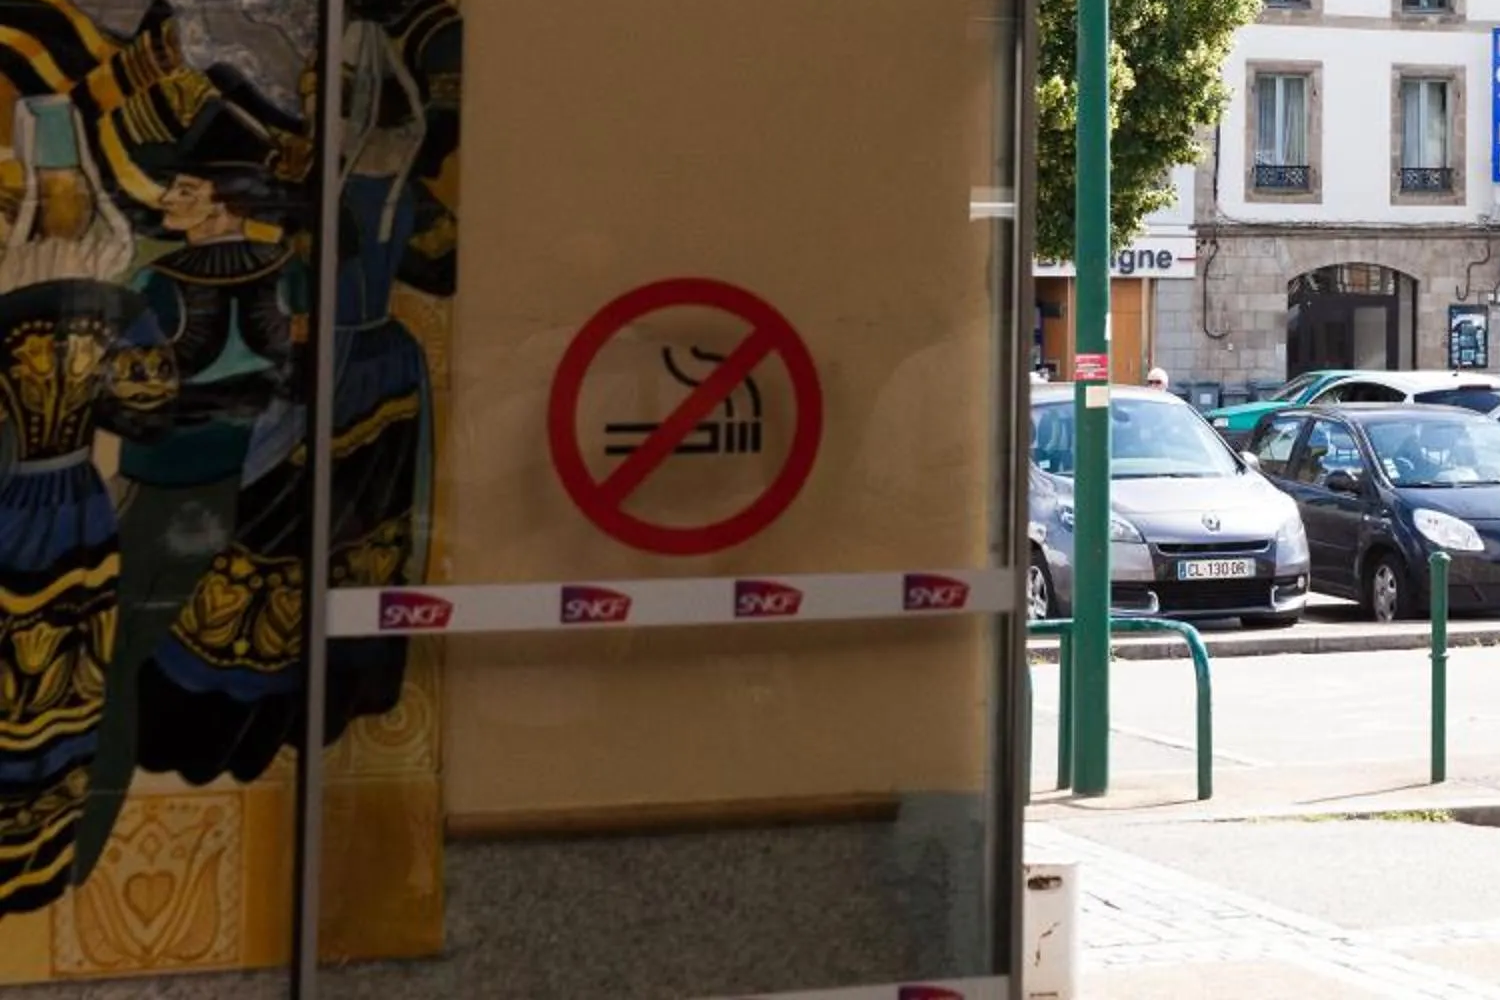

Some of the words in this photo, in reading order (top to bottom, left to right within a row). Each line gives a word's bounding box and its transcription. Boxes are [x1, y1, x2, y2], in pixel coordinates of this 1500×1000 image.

[736, 593, 794, 614] SNCF
[905, 586, 963, 607] SNCF
[383, 604, 447, 626] SNCF
[564, 598, 627, 620] SNCF
